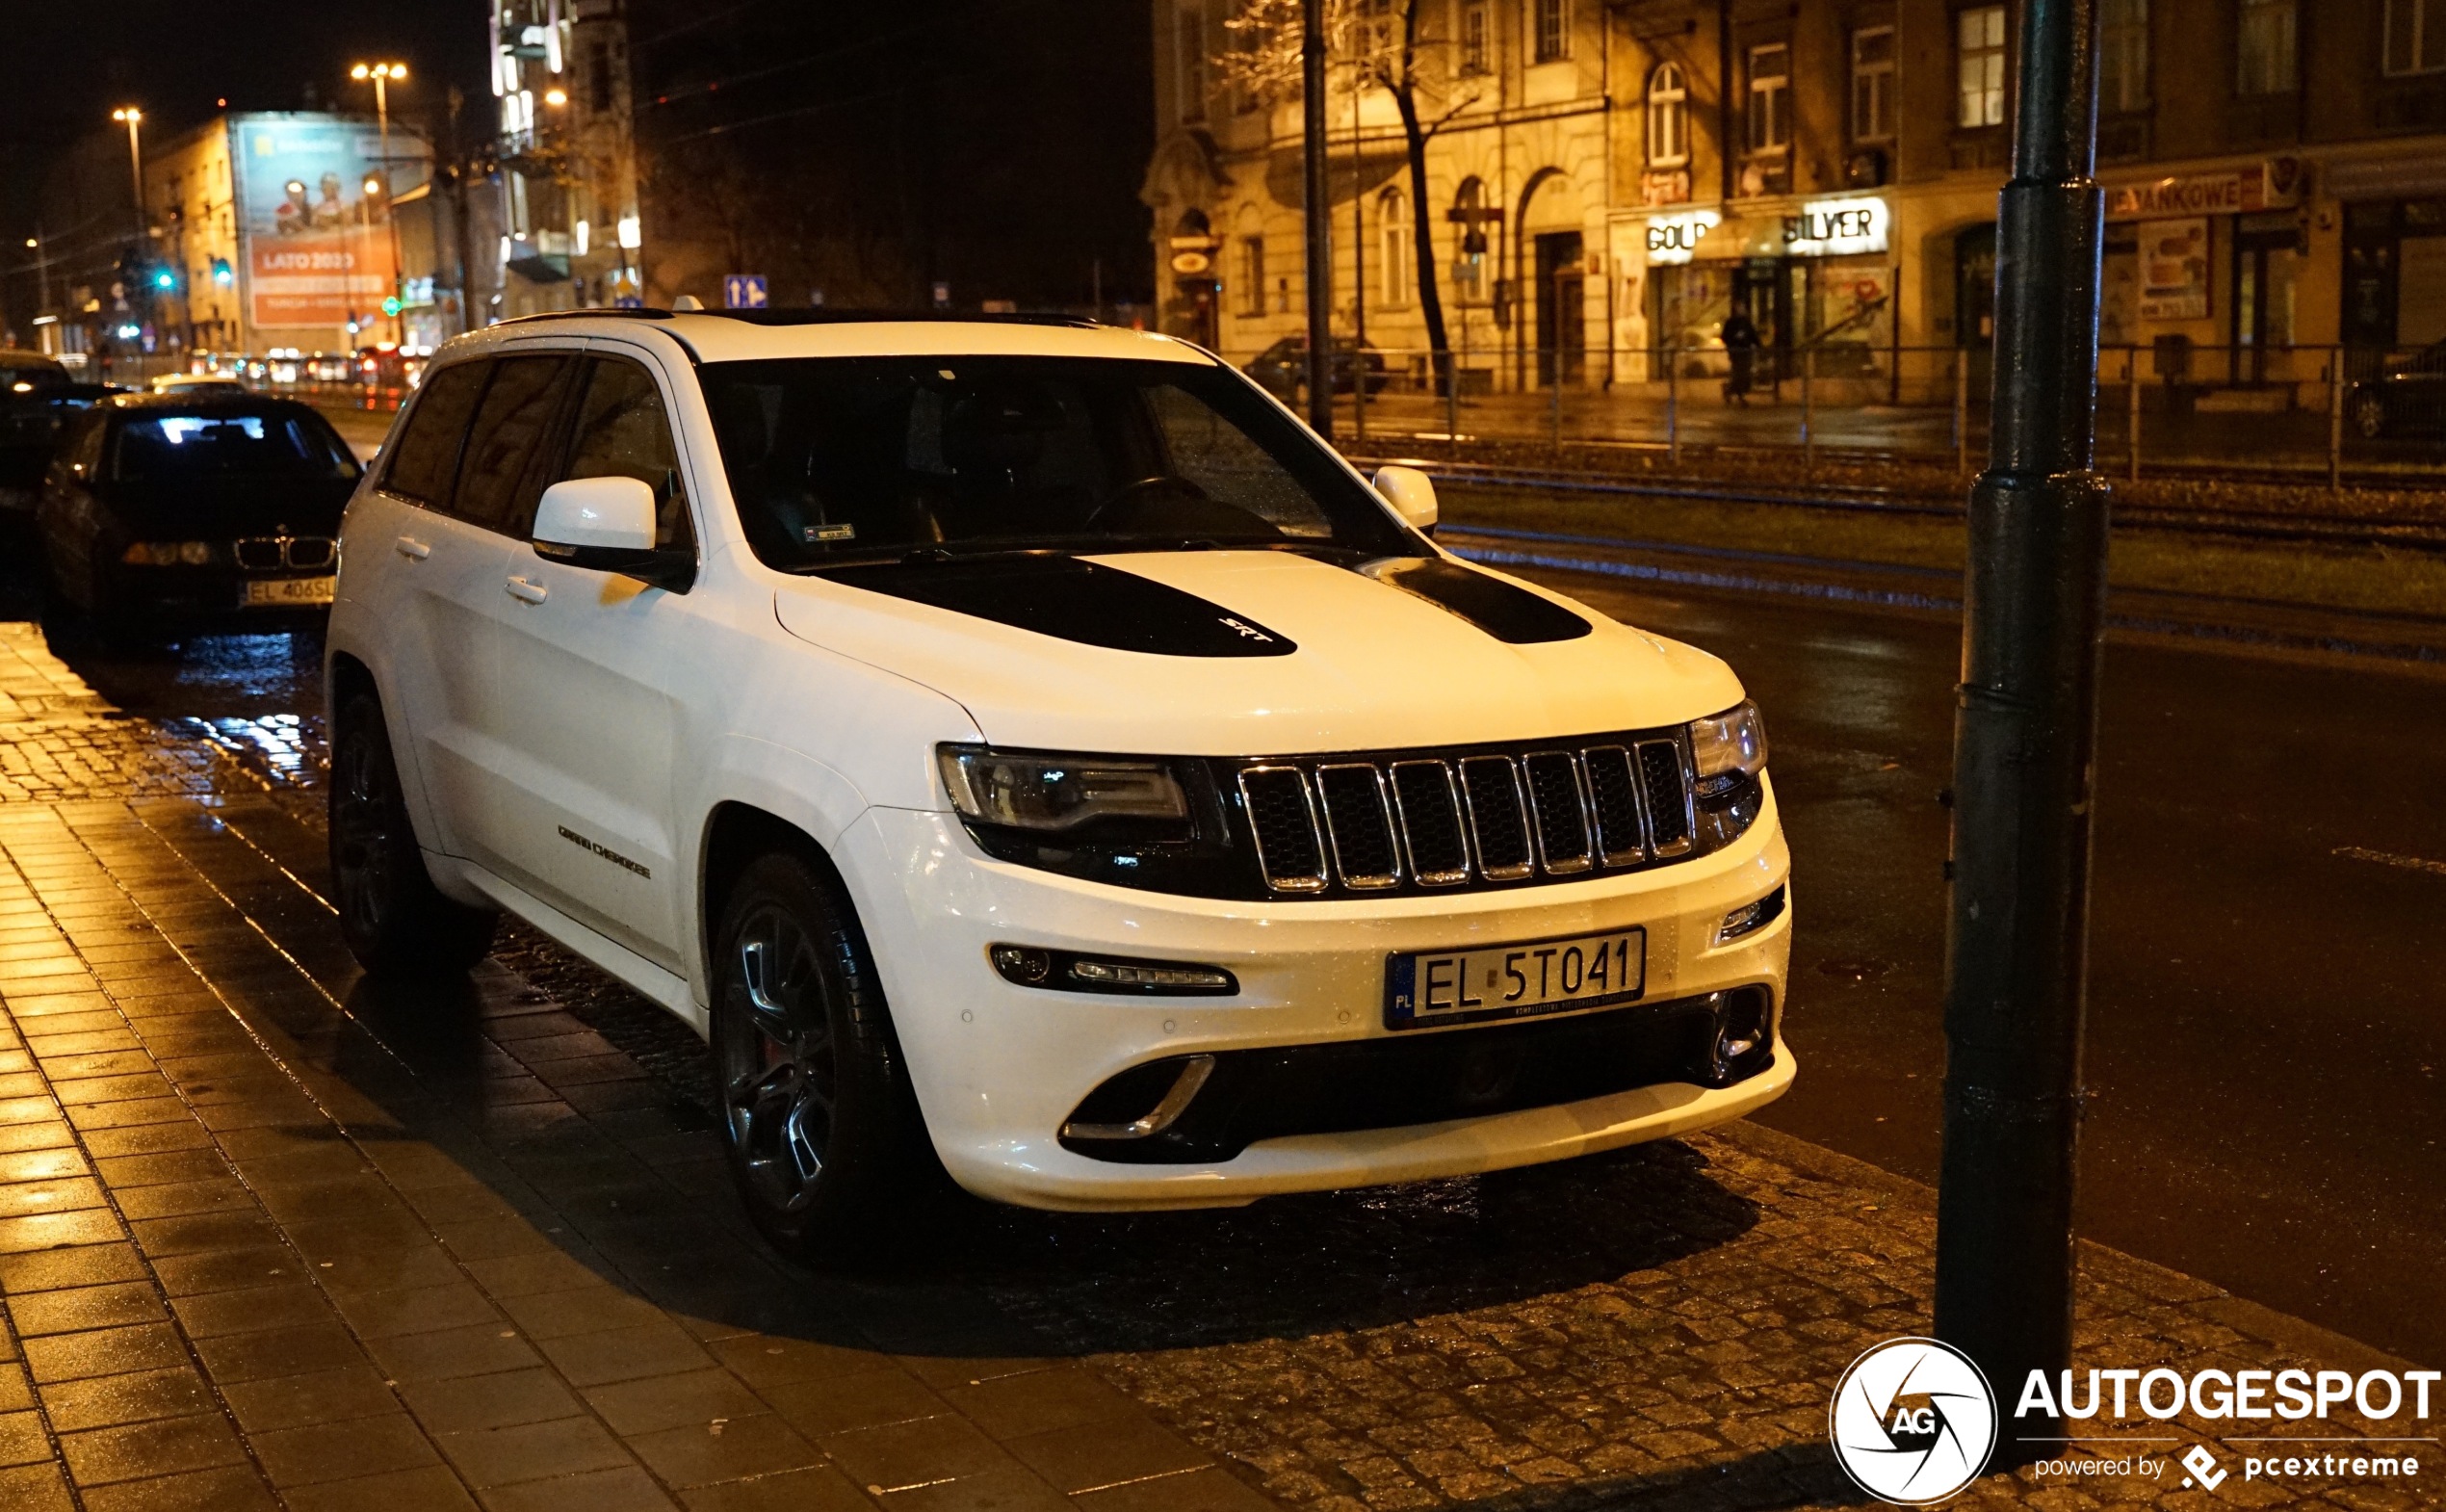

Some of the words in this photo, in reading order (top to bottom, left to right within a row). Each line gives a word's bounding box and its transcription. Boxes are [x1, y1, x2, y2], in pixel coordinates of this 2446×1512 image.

[1647, 223, 1710, 250] GOLD
[1783, 209, 1872, 241] SILVER
[263, 253, 310, 270] LATO
[251, 584, 275, 602] EL
[283, 581, 333, 598] 406SL
[1218, 618, 1273, 642] SRT
[1426, 957, 1482, 1009] EL
[1504, 938, 1628, 1002] 5T041
[1395, 995, 1412, 1008] PL
